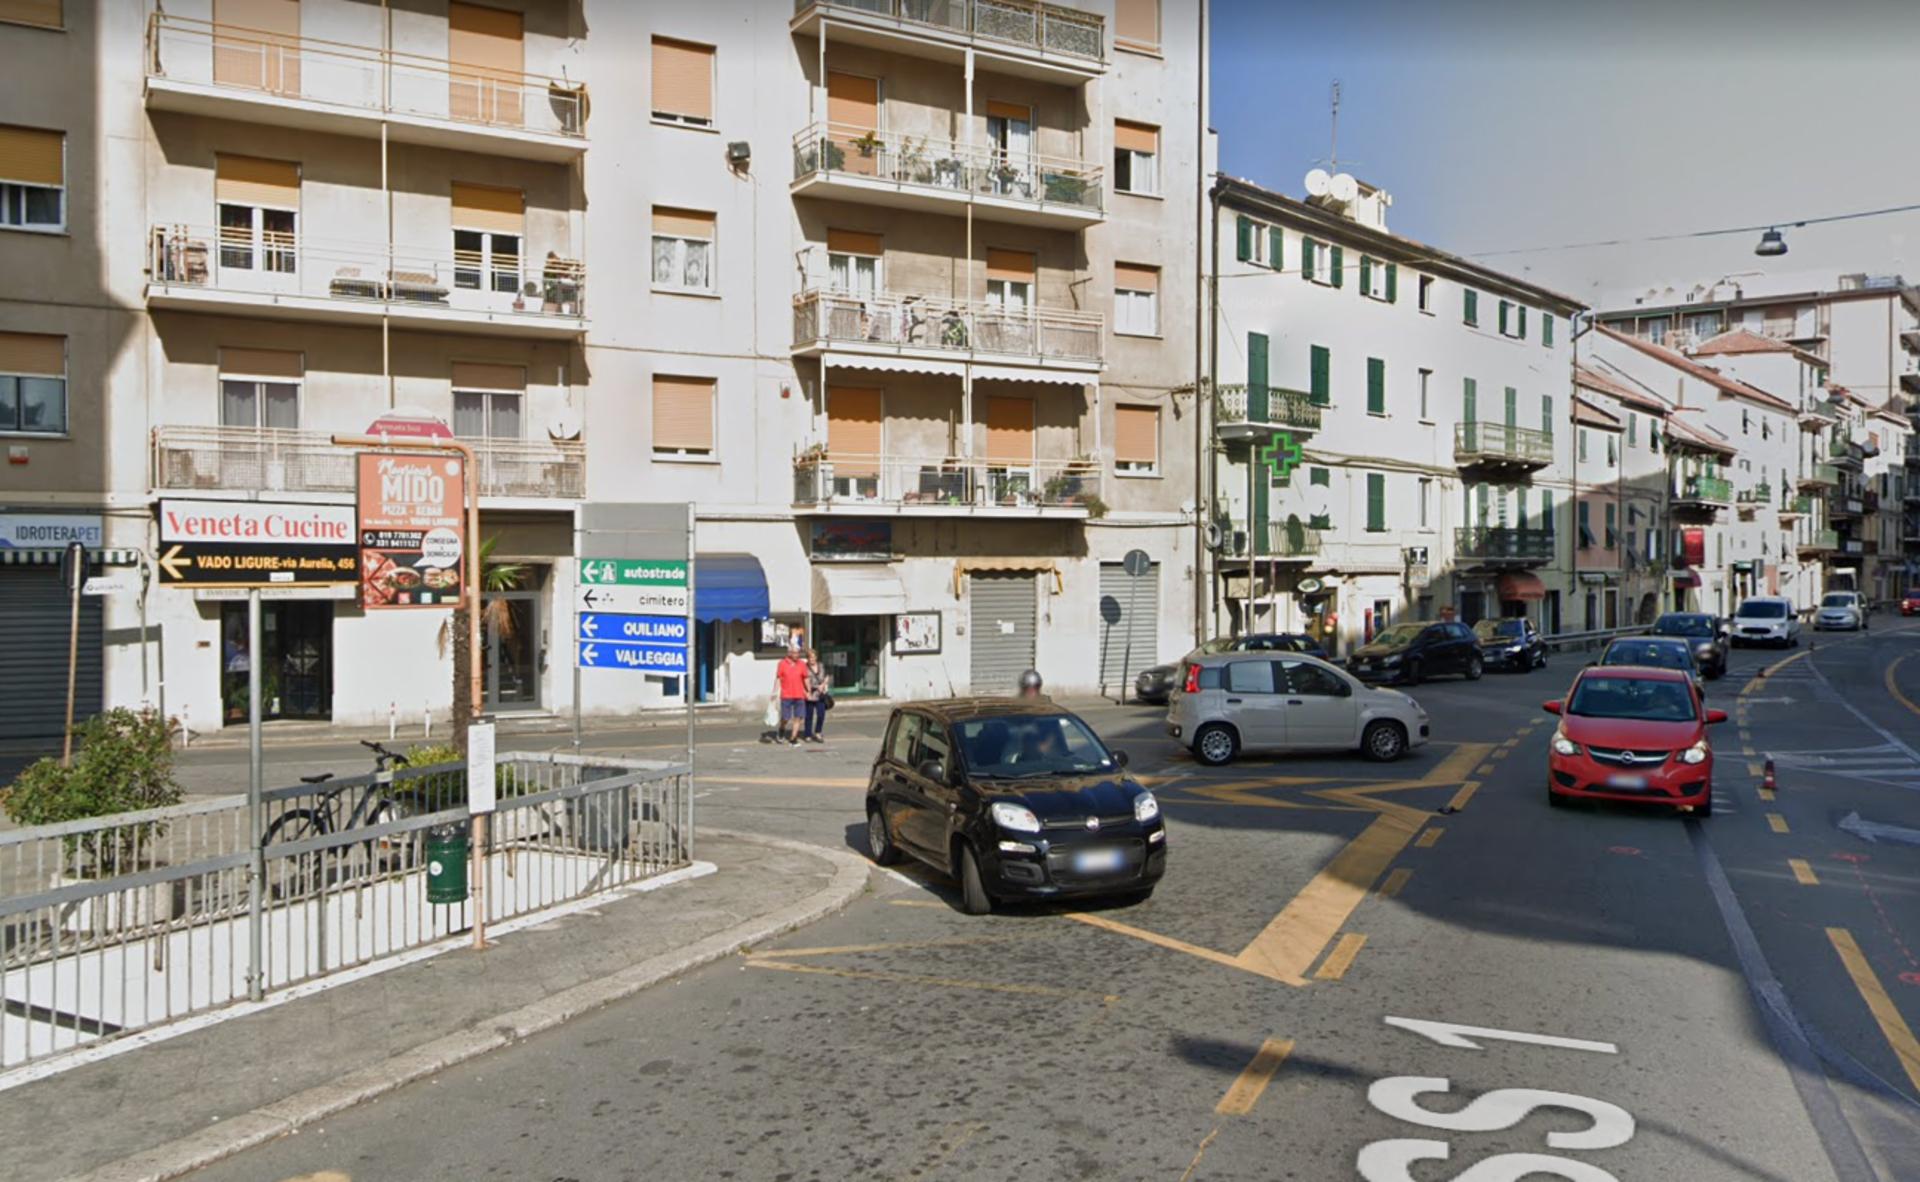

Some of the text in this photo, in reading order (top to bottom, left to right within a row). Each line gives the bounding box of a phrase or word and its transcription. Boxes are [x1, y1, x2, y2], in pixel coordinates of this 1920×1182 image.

[382, 475, 444, 503] MIDO
[382, 504, 407, 516] PIZZA
[167, 511, 348, 539] Veneta Cucine
[16, 526, 99, 541] IDROTERAPET
[197, 556, 231, 569] VADO
[299, 557, 337, 571] Aurelia,
[338, 558, 355, 570] 456
[623, 567, 686, 580] autostrade
[639, 595, 685, 607] cimitero
[623, 622, 685, 638] QUILIANO
[615, 649, 686, 667] VALLEGGIA
